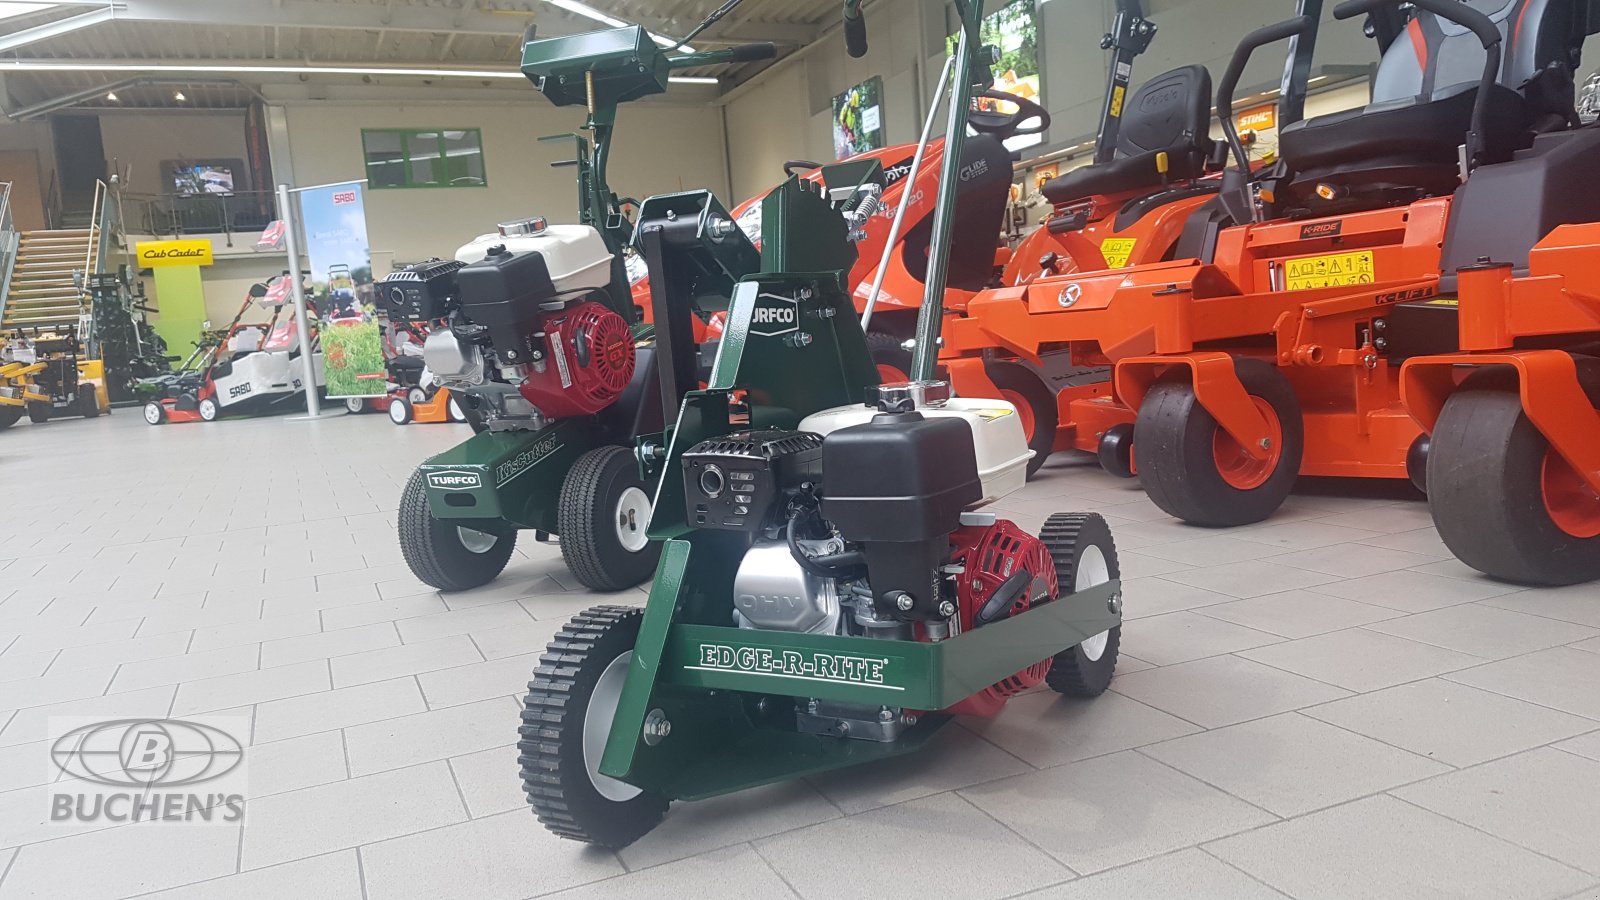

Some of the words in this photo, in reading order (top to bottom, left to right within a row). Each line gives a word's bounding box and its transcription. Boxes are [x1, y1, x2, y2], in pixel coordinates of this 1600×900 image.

[1240, 111, 1273, 127] STIHL
[334, 192, 355, 204] SABO
[1303, 223, 1337, 234] K-RIDE
[144, 250, 166, 258] Cub
[167, 248, 206, 258] Cadet
[1377, 287, 1433, 304] K-LIFT
[229, 382, 251, 398] SABO
[496, 436, 556, 483] KisCutter
[432, 476, 478, 485] TURFCO
